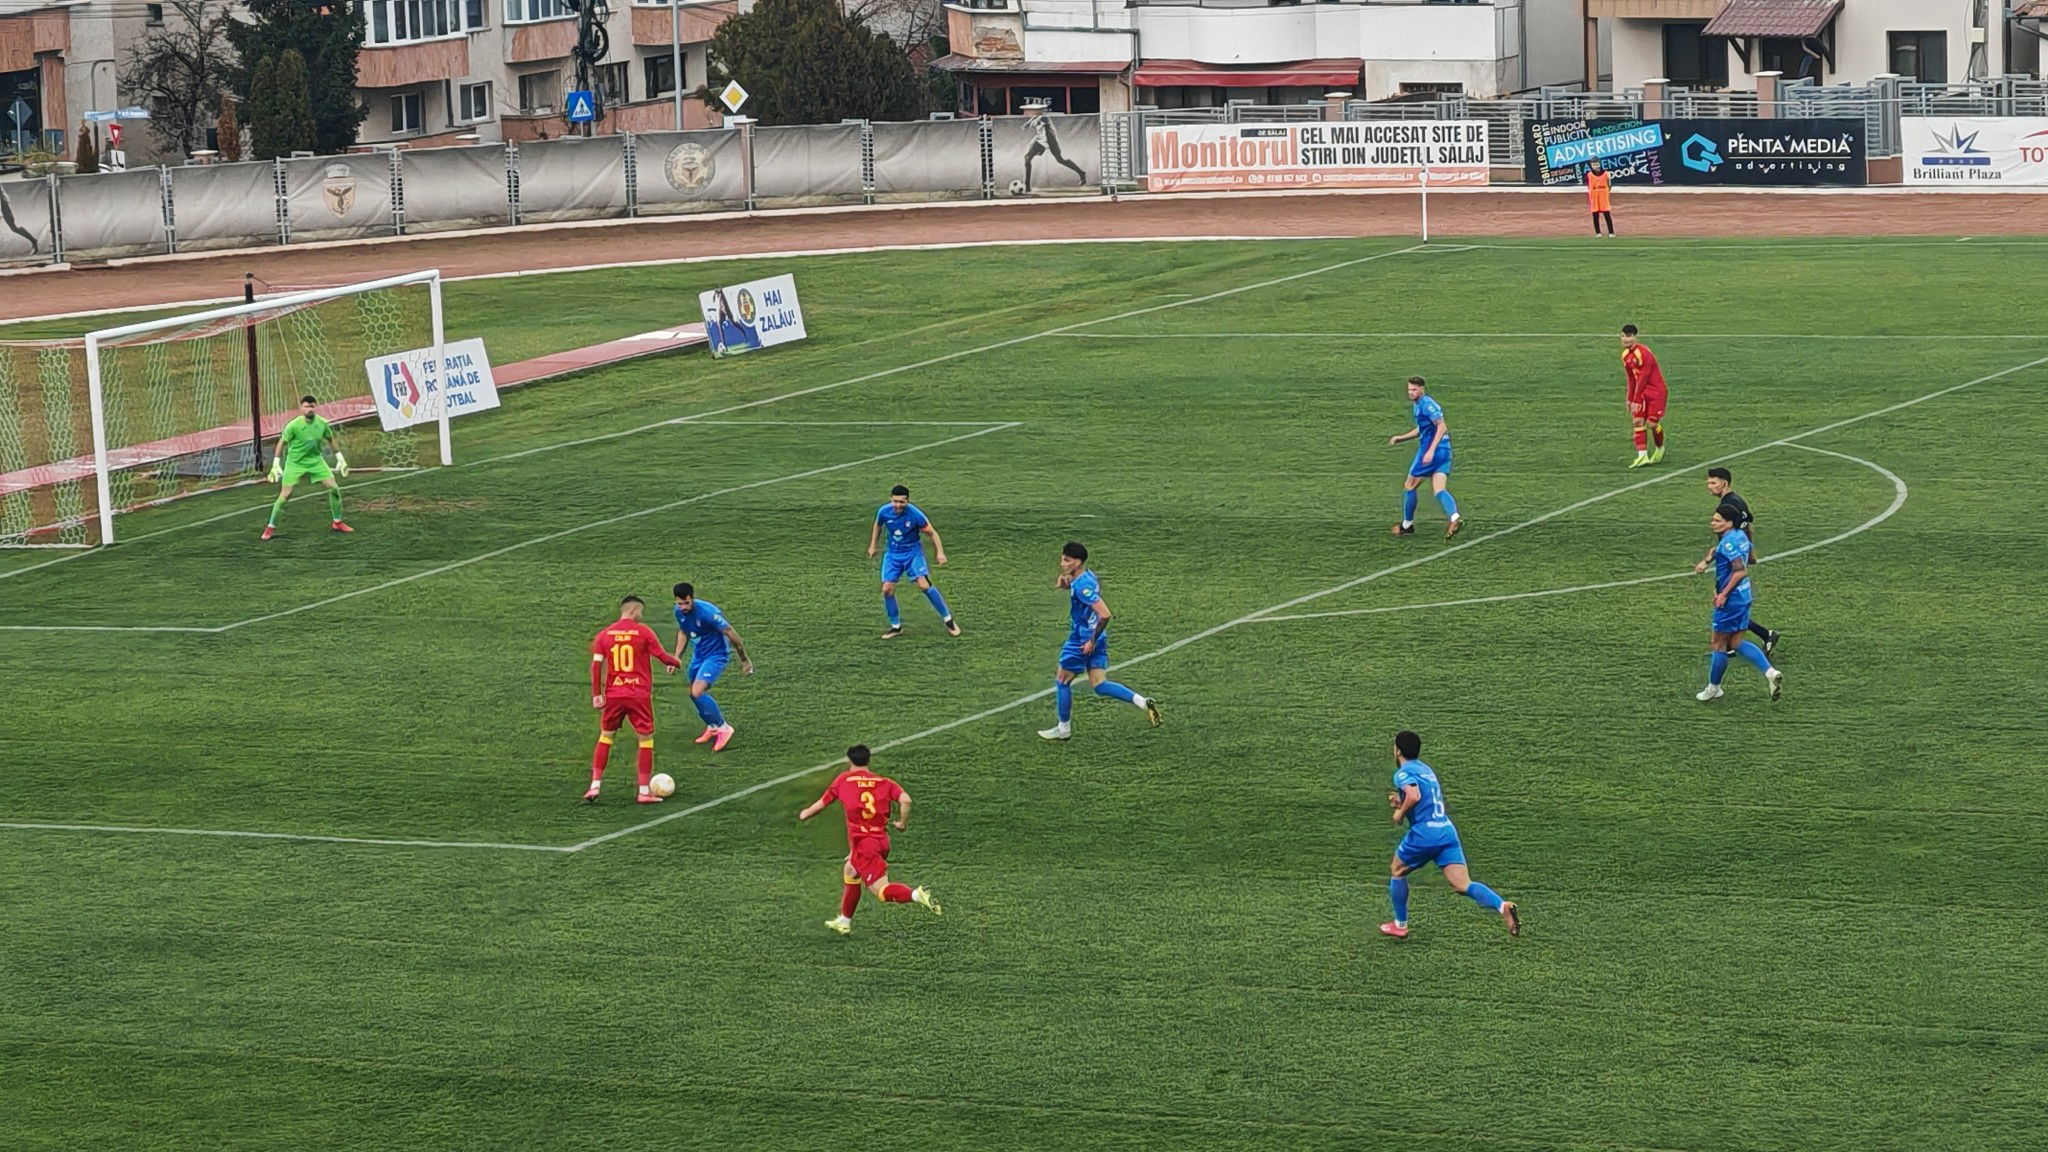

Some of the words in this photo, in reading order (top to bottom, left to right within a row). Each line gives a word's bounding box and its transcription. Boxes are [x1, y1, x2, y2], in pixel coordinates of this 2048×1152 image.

[1301, 127, 1326, 144] CEL
[1331, 127, 1359, 143] MAI
[1364, 126, 1427, 143] ACCESAT
[1432, 125, 1461, 142] SITE
[1466, 125, 1484, 142] DE
[1550, 121, 1586, 134] INDOOR
[1592, 121, 1643, 137] PRODUCTION
[1544, 128, 1593, 146] PUBLICITY
[1151, 127, 1297, 169] Monitorul
[1554, 129, 1657, 164] ADVERTISING
[1728, 138, 1785, 154] PENTA
[1789, 138, 1851, 154] MEDIA
[1342, 147, 1366, 164] DIN
[1583, 154, 1634, 175] AENCY
[1735, 160, 1845, 171] advertising
[1913, 168, 1964, 180] Brilliant
[1968, 168, 2002, 180] Plaza
[763, 290, 783, 307] HAI
[759, 308, 797, 333] ZALĂU!
[466, 371, 481, 385] DE
[610, 643, 634, 672] 10
[860, 791, 877, 819] 3
